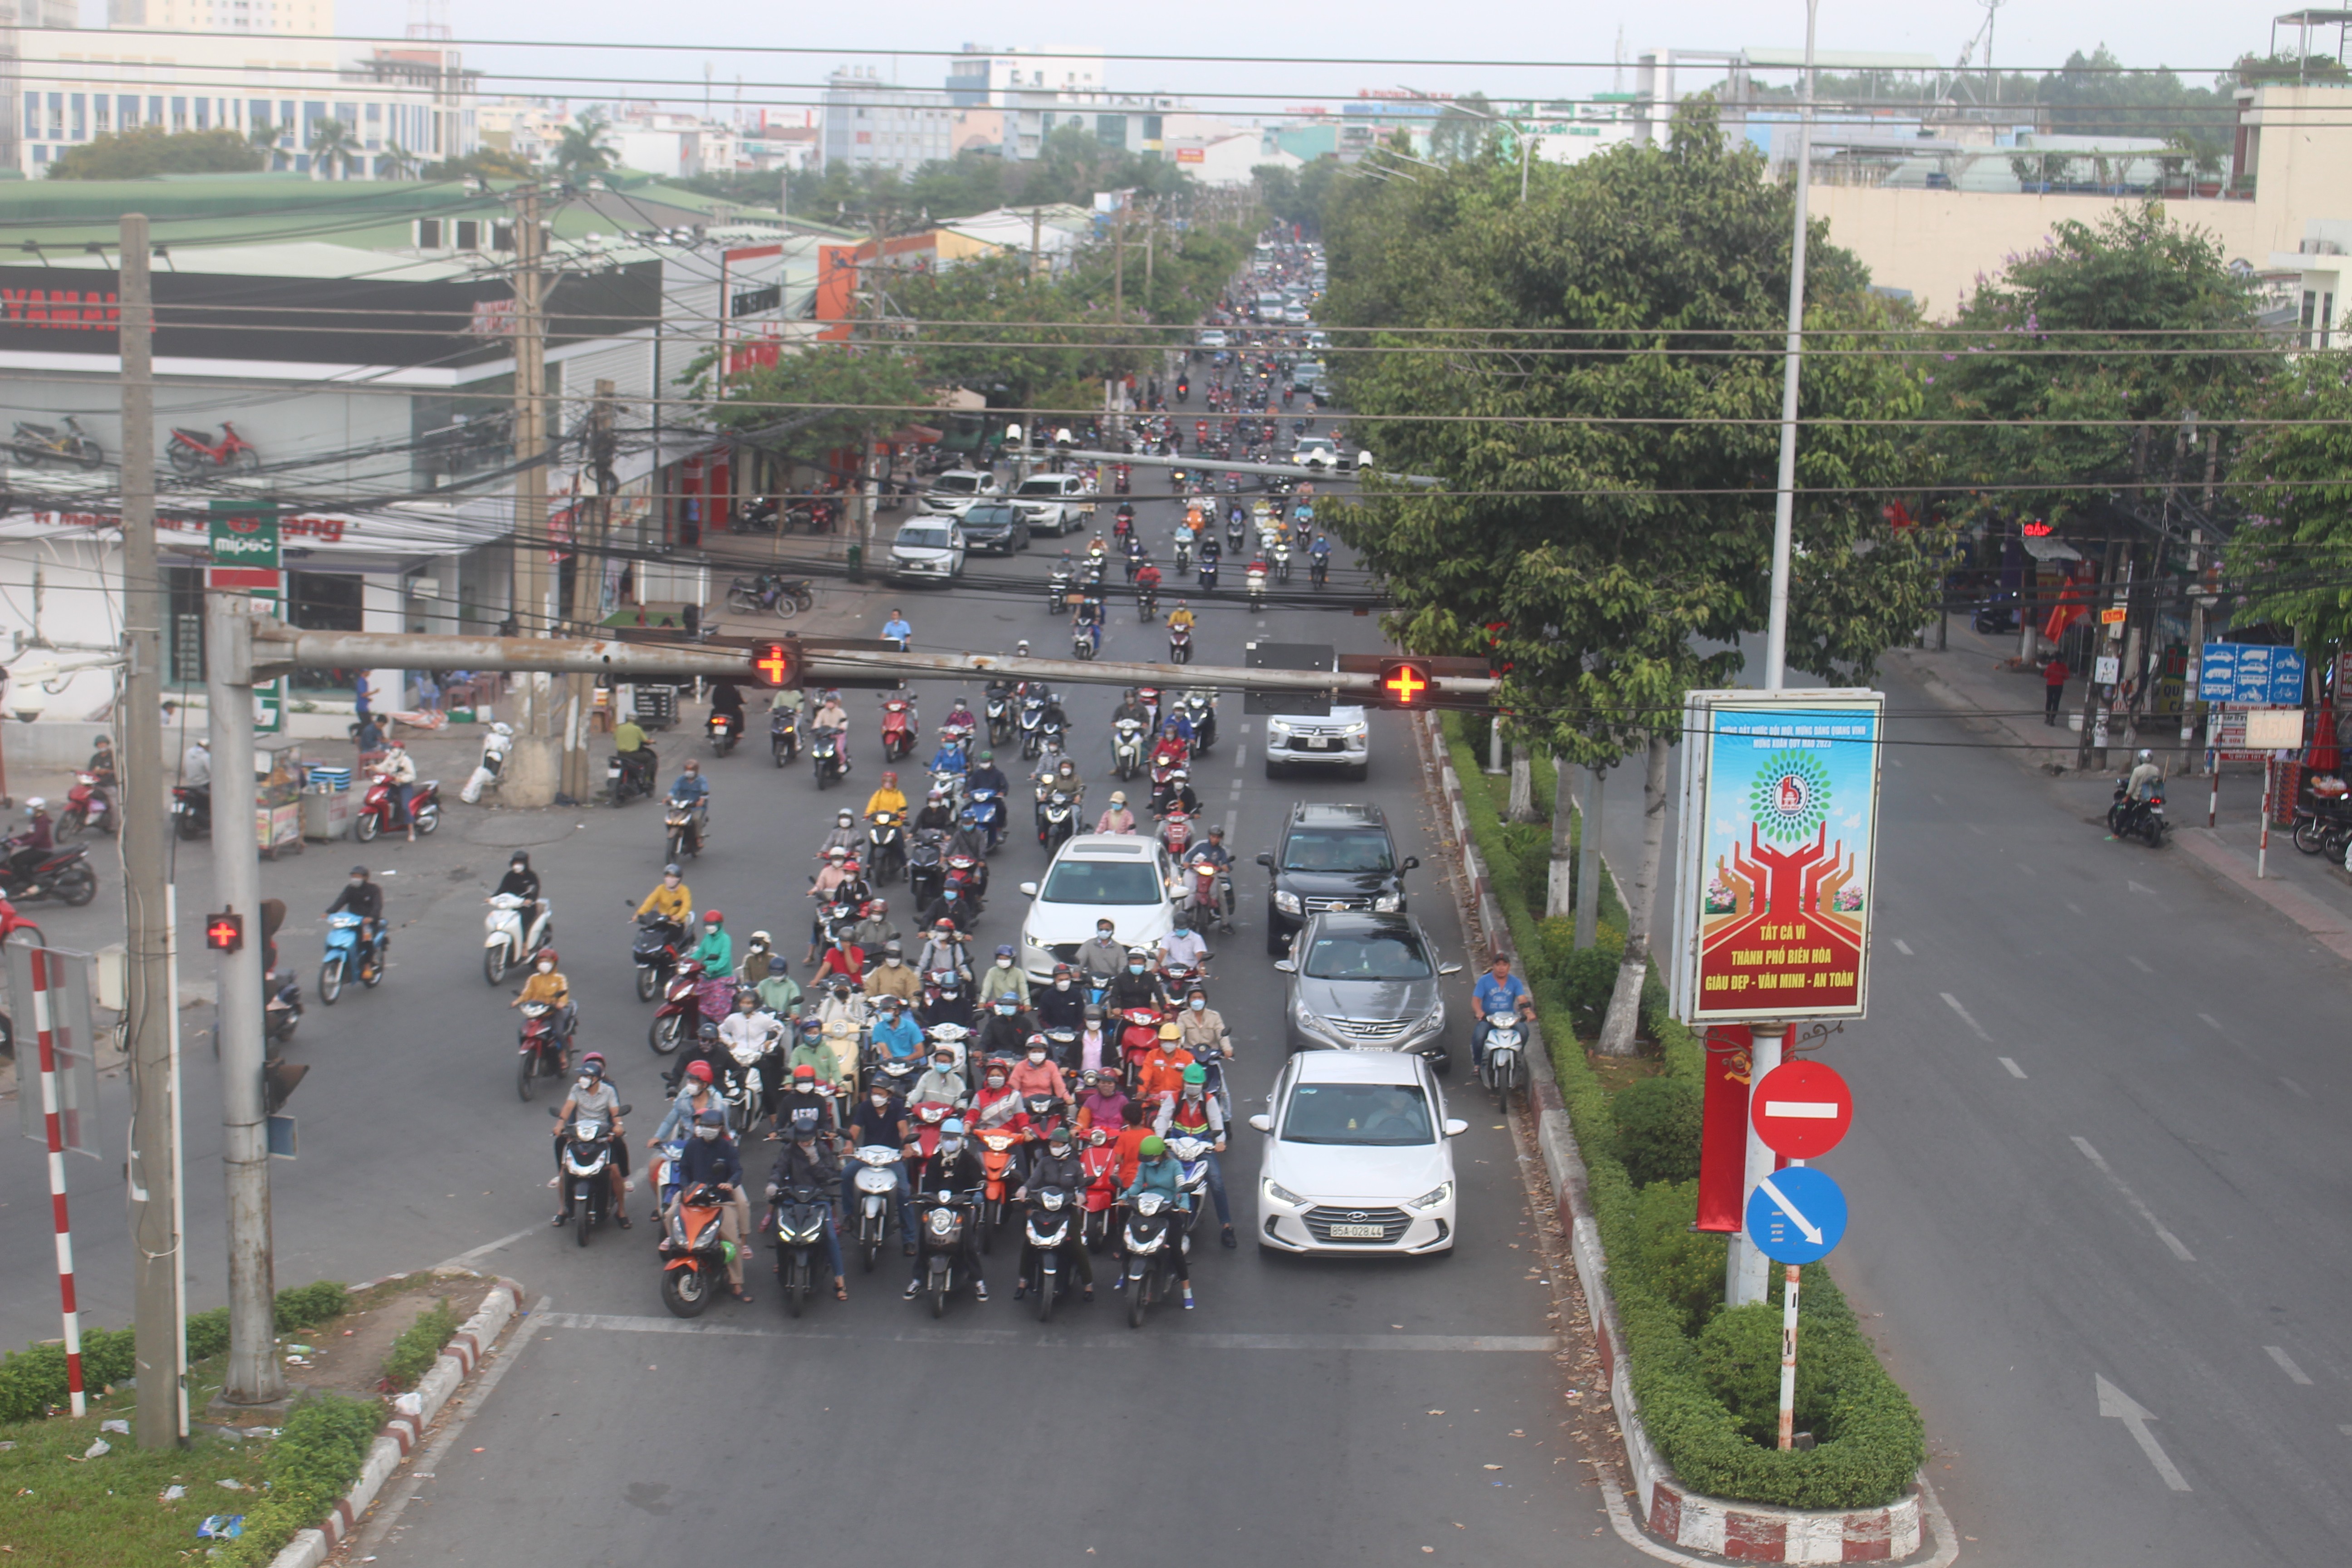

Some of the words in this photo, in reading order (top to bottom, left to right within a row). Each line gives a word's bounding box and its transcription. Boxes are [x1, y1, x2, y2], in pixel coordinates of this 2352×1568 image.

[2, 289, 157, 333] YAMAH
[1760, 921, 1778, 941] TẤT
[1779, 922, 1793, 941] CẢ
[1796, 923, 1806, 940] VÌ
[1731, 948, 1764, 966] THÀNH
[1765, 945, 1785, 965] PHỐ
[1787, 947, 1810, 964] BIÊN
[1811, 946, 1831, 964] HÒA
[1705, 974, 1729, 991] GIÀU
[1730, 975, 1749, 993] ĐẸP
[1758, 972, 1777, 989] VĂN
[1779, 974, 1805, 989] MINH
[1813, 973, 1827, 988] AN
[1829, 970, 1854, 987] TOÀN
